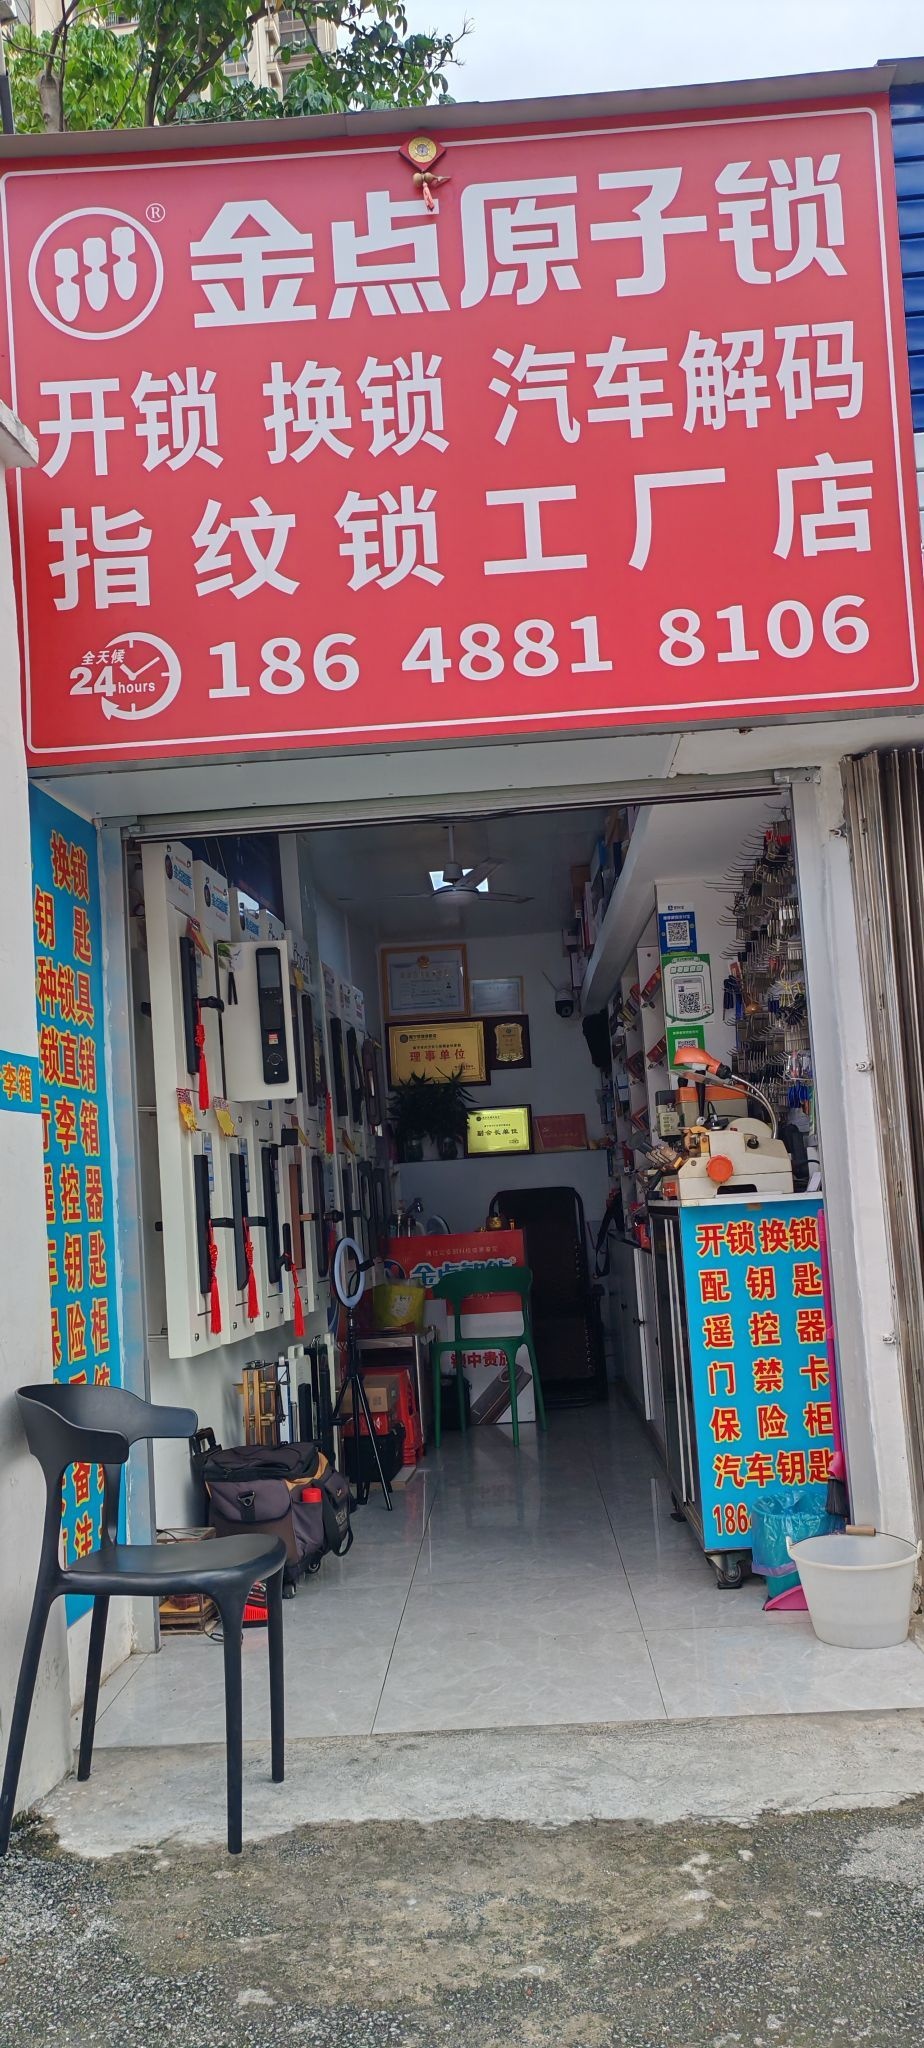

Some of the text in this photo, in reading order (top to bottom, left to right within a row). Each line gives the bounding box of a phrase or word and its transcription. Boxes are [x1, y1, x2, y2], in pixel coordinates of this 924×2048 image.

[190, 154, 847, 328] 金点原子锁
[38, 321, 863, 478] 开锁 换锁 汽车解码
[48, 452, 874, 611] 指纹锁工厂店
[81, 649, 126, 666] 全天候
[208, 595, 870, 699] 186 4881 8106
[51, 830, 89, 904] 换锁
[36, 956, 94, 1030] 种锁具
[40, 1023, 97, 1094] 锁直销
[409, 1048, 466, 1063] 理事单位
[695, 1216, 820, 1258] 开锁换锁
[699, 1262, 824, 1303] 配钥匙
[702, 1308, 827, 1350] 遥控器
[707, 1354, 830, 1396] 门禁卡
[709, 1403, 835, 1443] 保险柜
[712, 1448, 834, 1490] 汽车钥匙
[712, 1502, 752, 1536] 186
